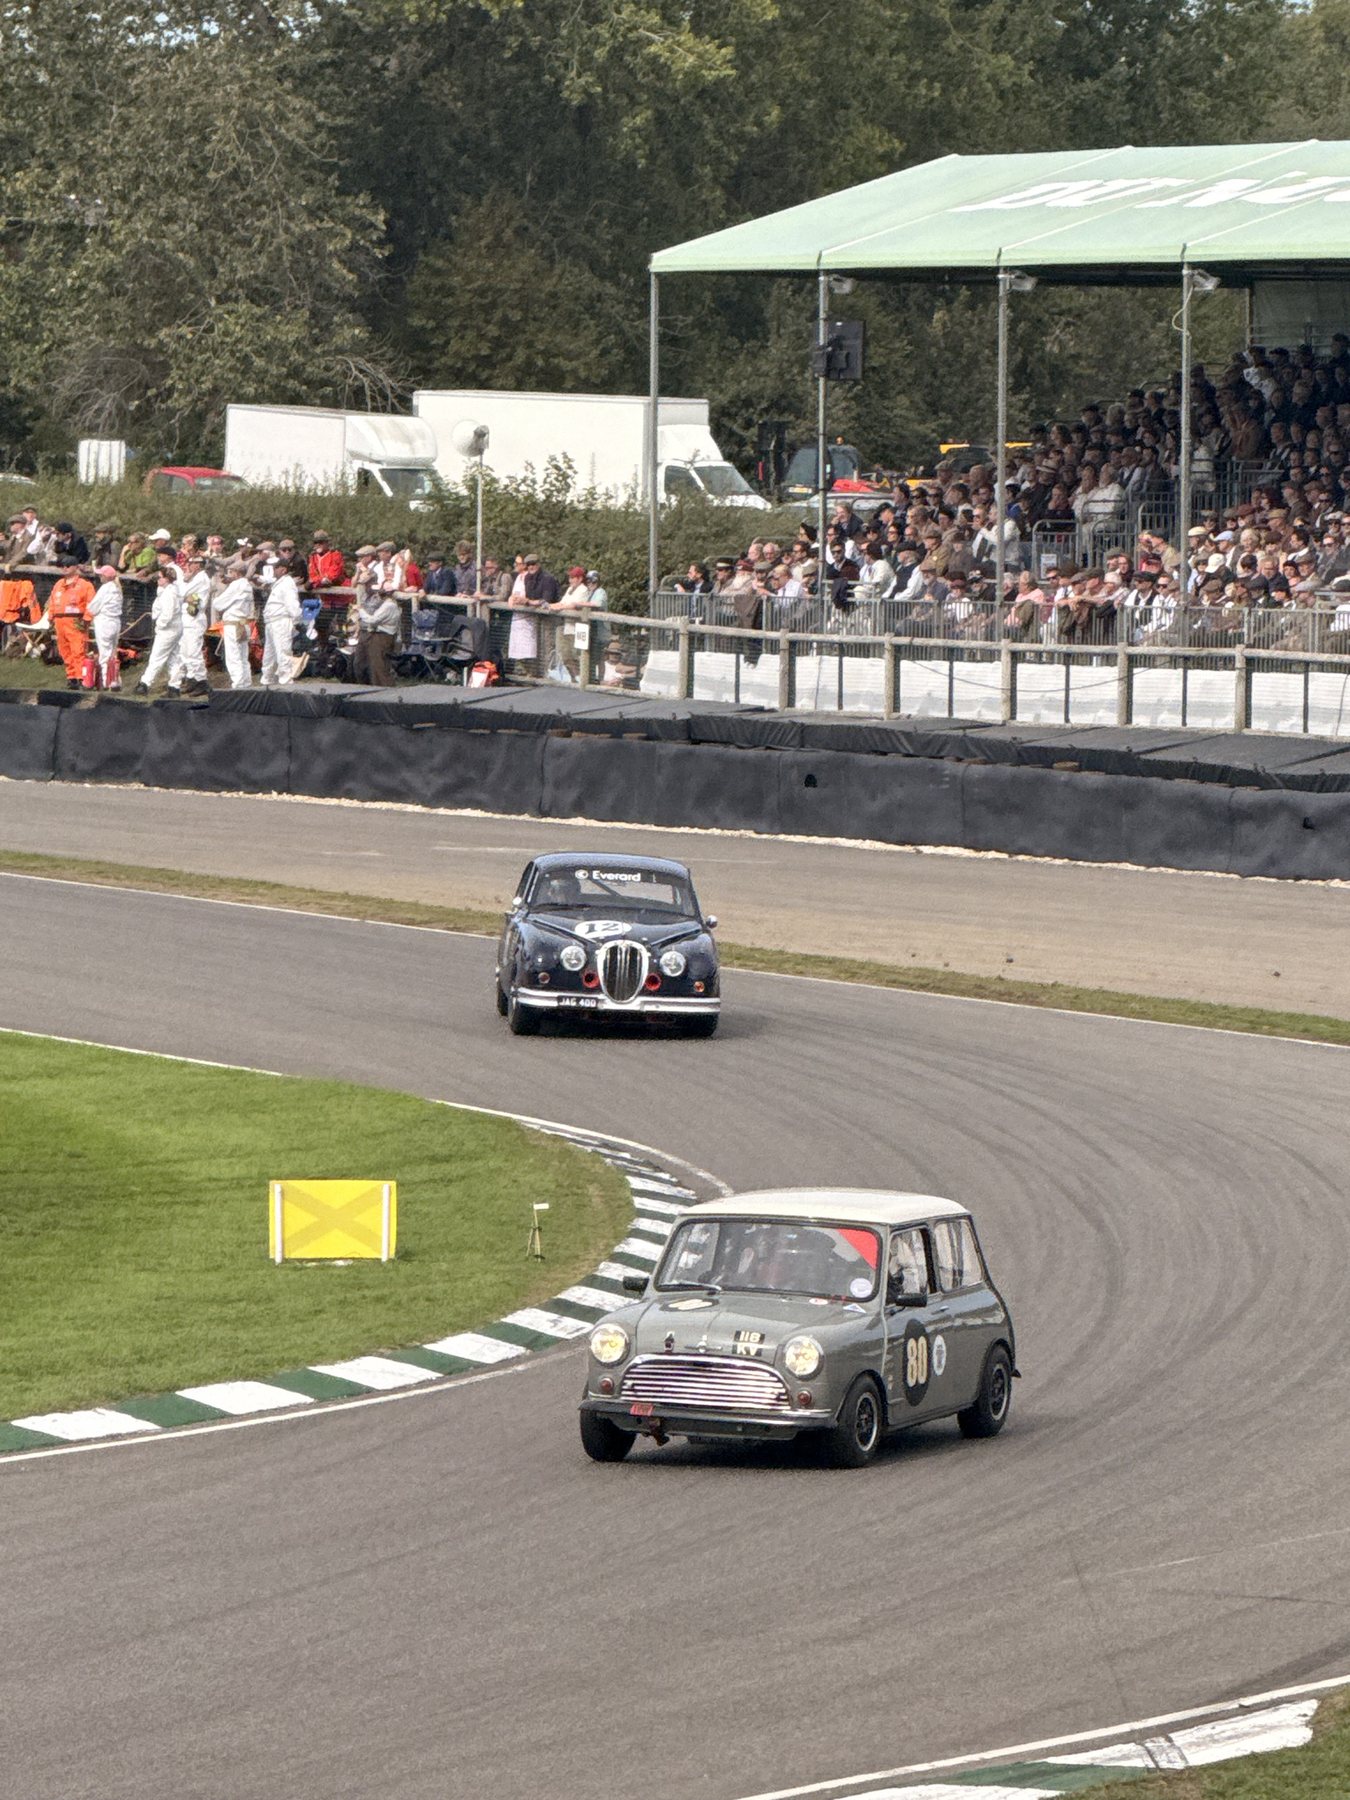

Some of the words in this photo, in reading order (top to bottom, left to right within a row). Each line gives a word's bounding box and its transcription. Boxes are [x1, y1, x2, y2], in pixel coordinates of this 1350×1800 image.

[592, 870, 641, 881] Everard
[584, 922, 619, 935] 12
[559, 997, 577, 1007] JAG
[740, 1331, 761, 1343] 118
[736, 1344, 759, 1356] KV
[906, 1335, 928, 1388] 80
